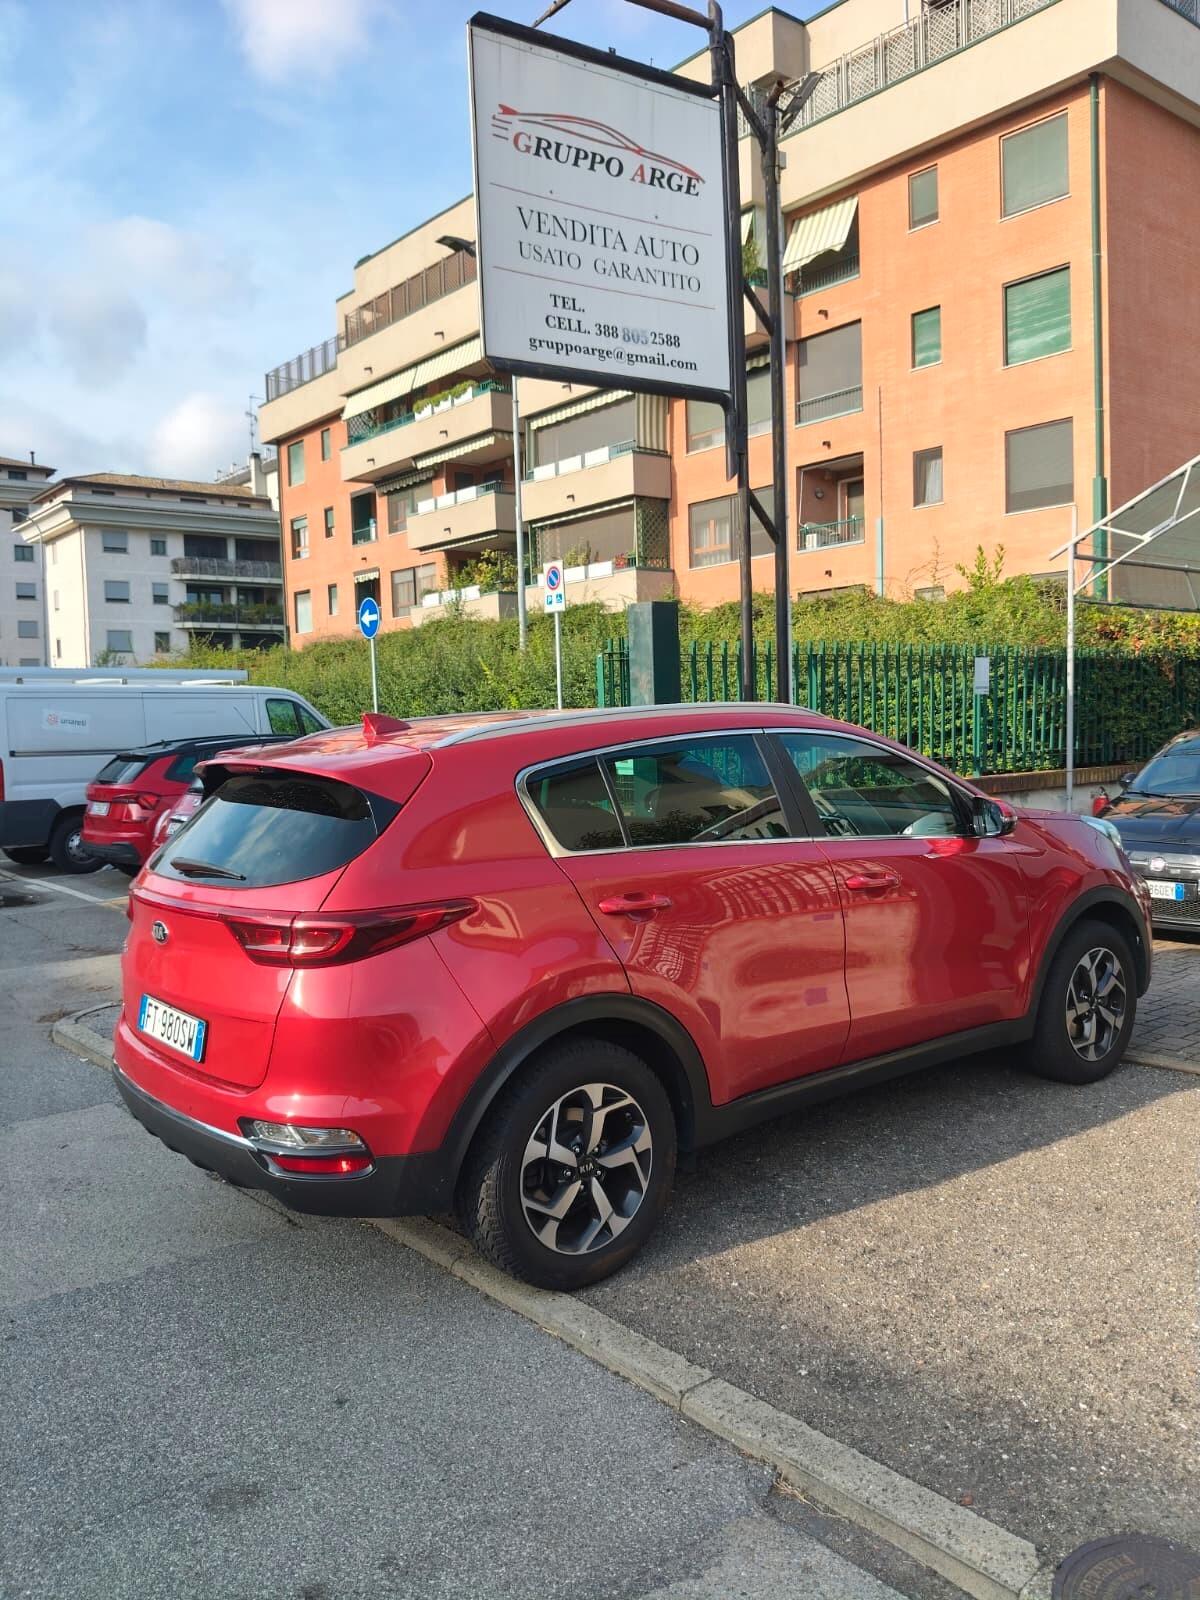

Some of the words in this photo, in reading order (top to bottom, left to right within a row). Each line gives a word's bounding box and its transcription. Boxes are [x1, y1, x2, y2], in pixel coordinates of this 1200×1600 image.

[512, 131, 624, 178] GRUPPO
[629, 163, 701, 197] ARGE
[516, 206, 628, 253] VENDITA
[633, 234, 700, 266] AUTO
[518, 240, 582, 270] USATO
[593, 257, 701, 293] GARANTITO
[549, 293, 586, 313] TEL.
[544, 314, 591, 335] CELL.
[594, 323, 619, 339] 388
[529, 336, 698, 371] gruppoarge@gmail.com
[145, 1002, 159, 1033] FT
[161, 1009, 201, 1053] 980SW
[579, 1162, 594, 1175] KIA
